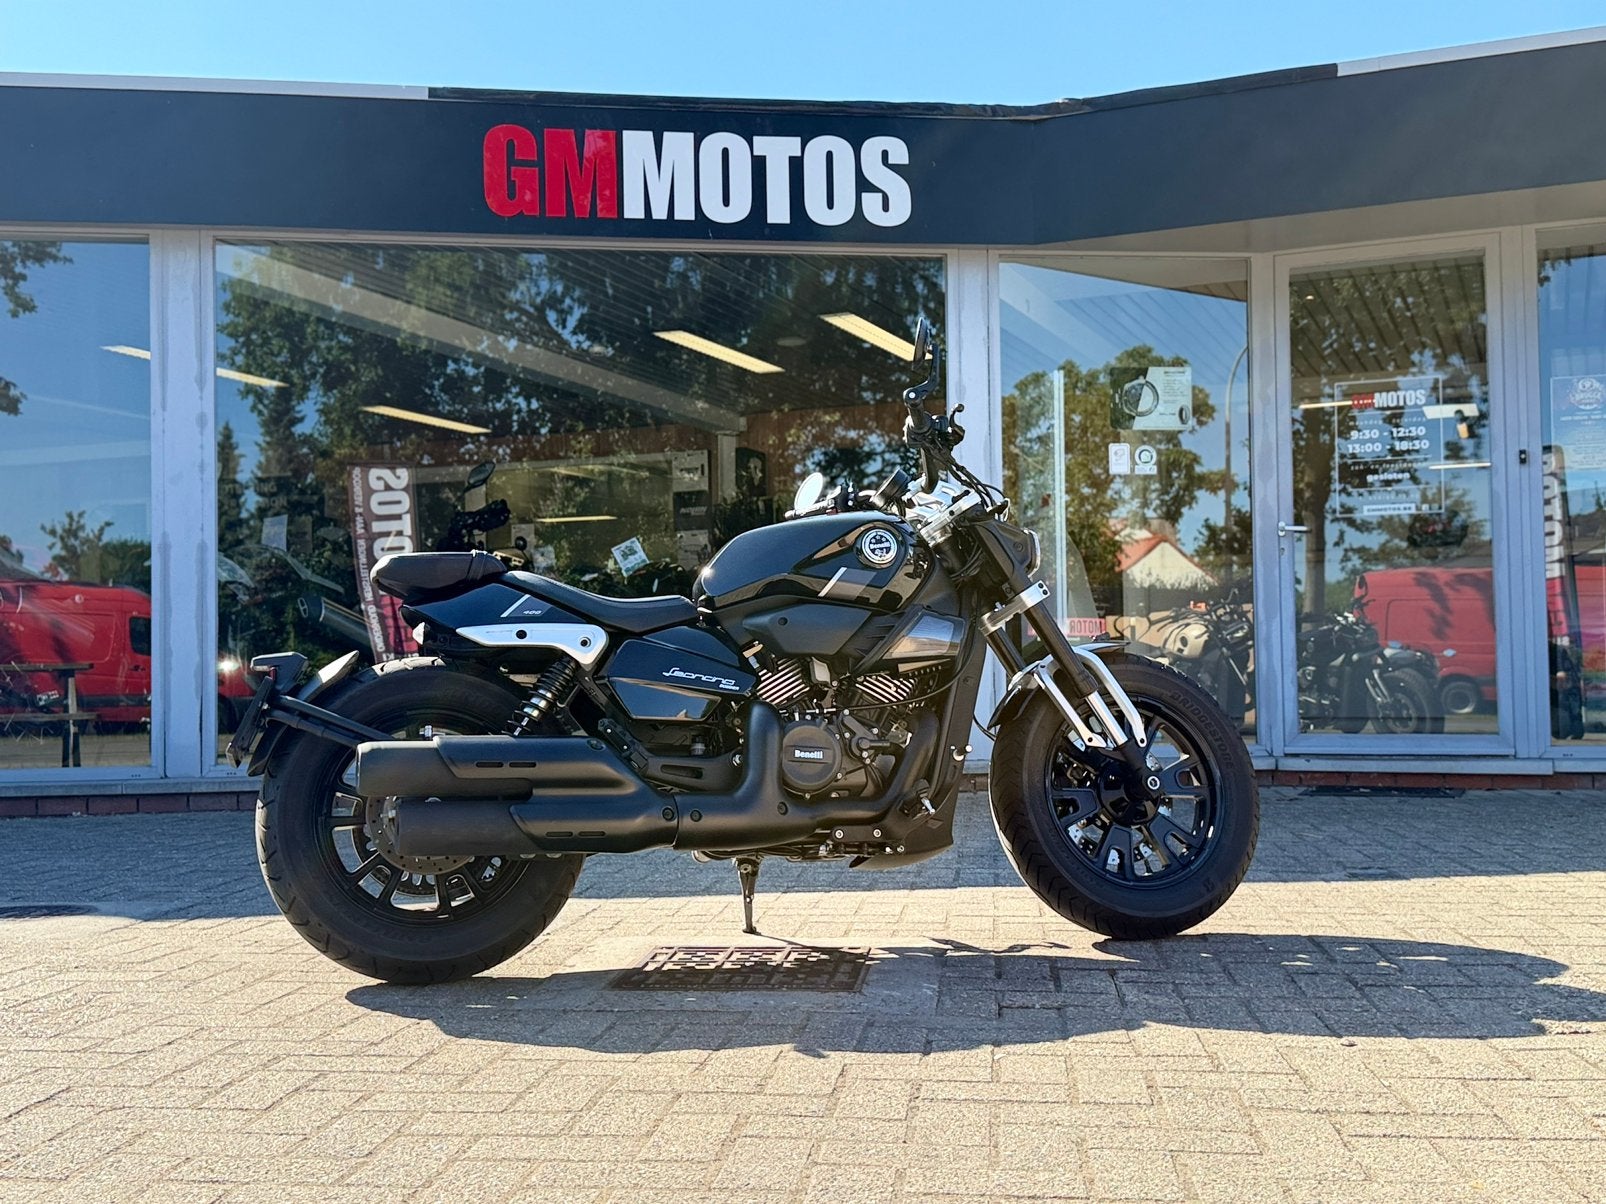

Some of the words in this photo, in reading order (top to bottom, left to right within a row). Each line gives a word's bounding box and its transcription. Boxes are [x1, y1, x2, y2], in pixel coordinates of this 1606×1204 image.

[483, 124, 911, 227] GMMOTOS
[1350, 429, 1379, 440] 9:30
[1391, 426, 1426, 438] 12:30
[1347, 442, 1382, 454] 13:00
[1394, 439, 1430, 451] 18:30
[1366, 472, 1411, 482] gesloten
[794, 749, 823, 759] Benelli
